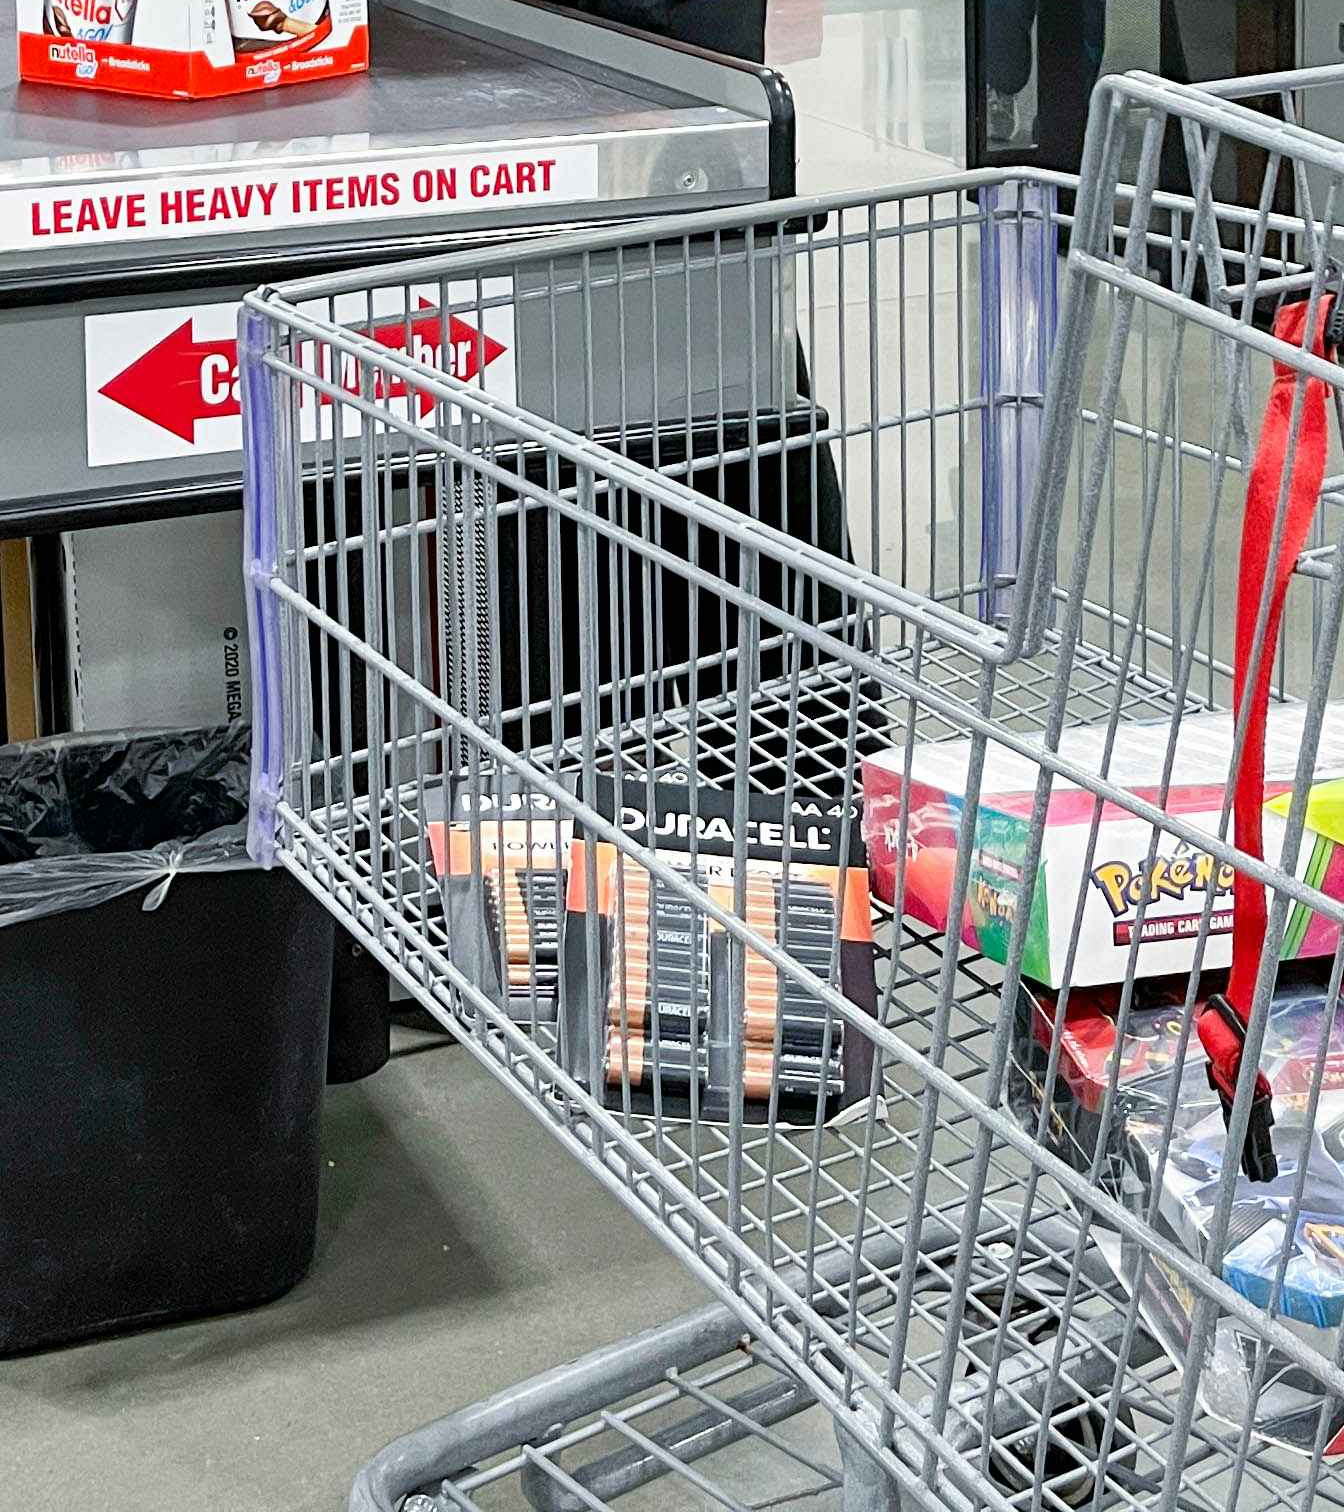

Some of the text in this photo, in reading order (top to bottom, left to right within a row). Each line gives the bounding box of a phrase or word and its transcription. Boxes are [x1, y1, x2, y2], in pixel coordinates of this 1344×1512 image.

[51, 45, 94, 62] nutella
[31, 159, 556, 236] LEAVE HEAVY ITEMS ON CART
[322, 334, 471, 396] Mber
[224, 644, 239, 677] 2020
[226, 681, 242, 723] MEGA
[791, 801, 858, 819] AA 40
[1128, 915, 1234, 938] TADING CAR GAM
